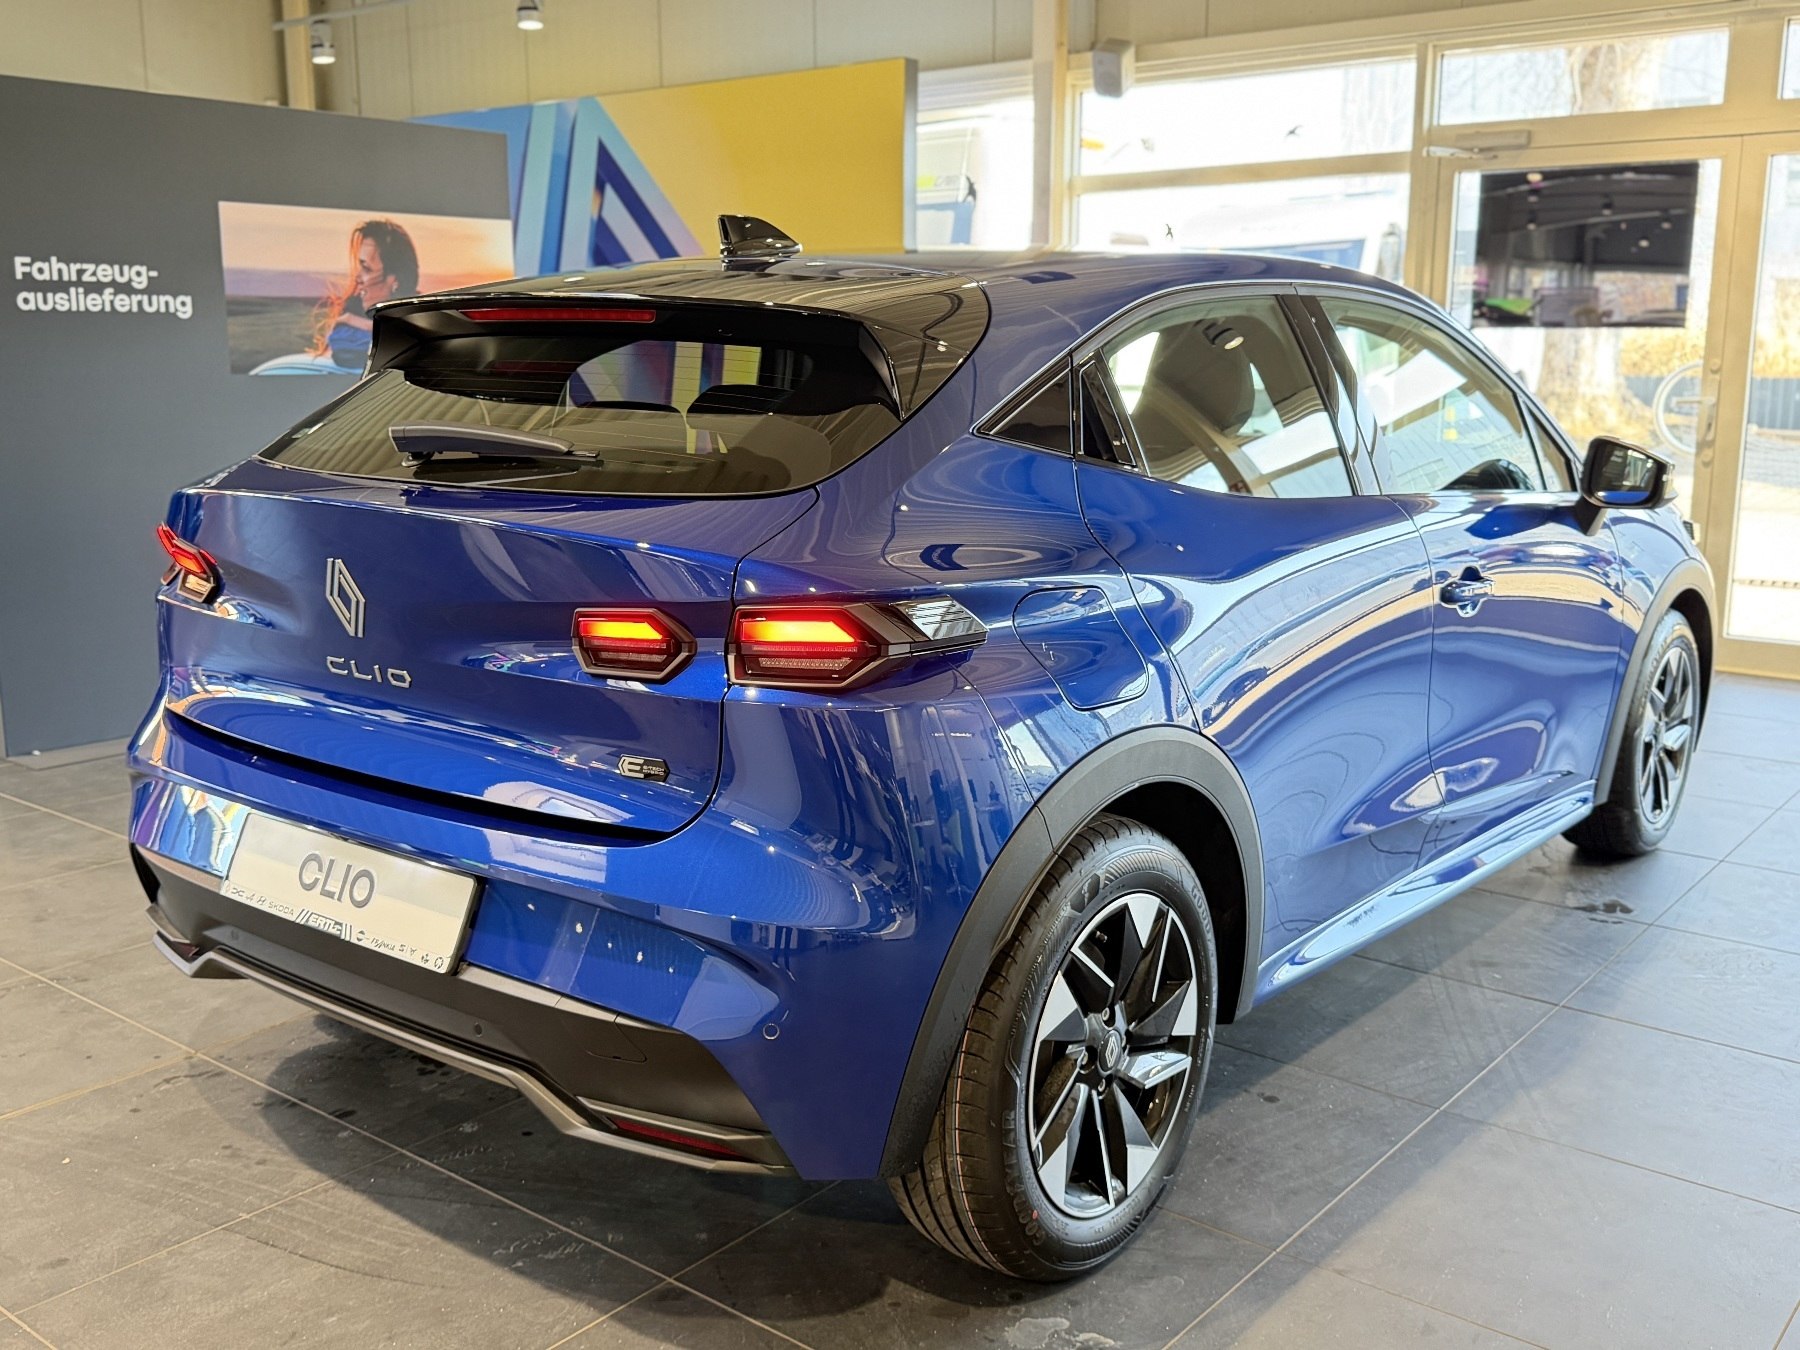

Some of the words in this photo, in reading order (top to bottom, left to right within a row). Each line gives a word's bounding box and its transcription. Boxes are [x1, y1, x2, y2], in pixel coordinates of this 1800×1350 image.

[14, 256, 159, 290] Fahrzeug-
[16, 287, 193, 320] auslieferung
[326, 656, 412, 689] CLIO
[298, 853, 375, 908] CLIO
